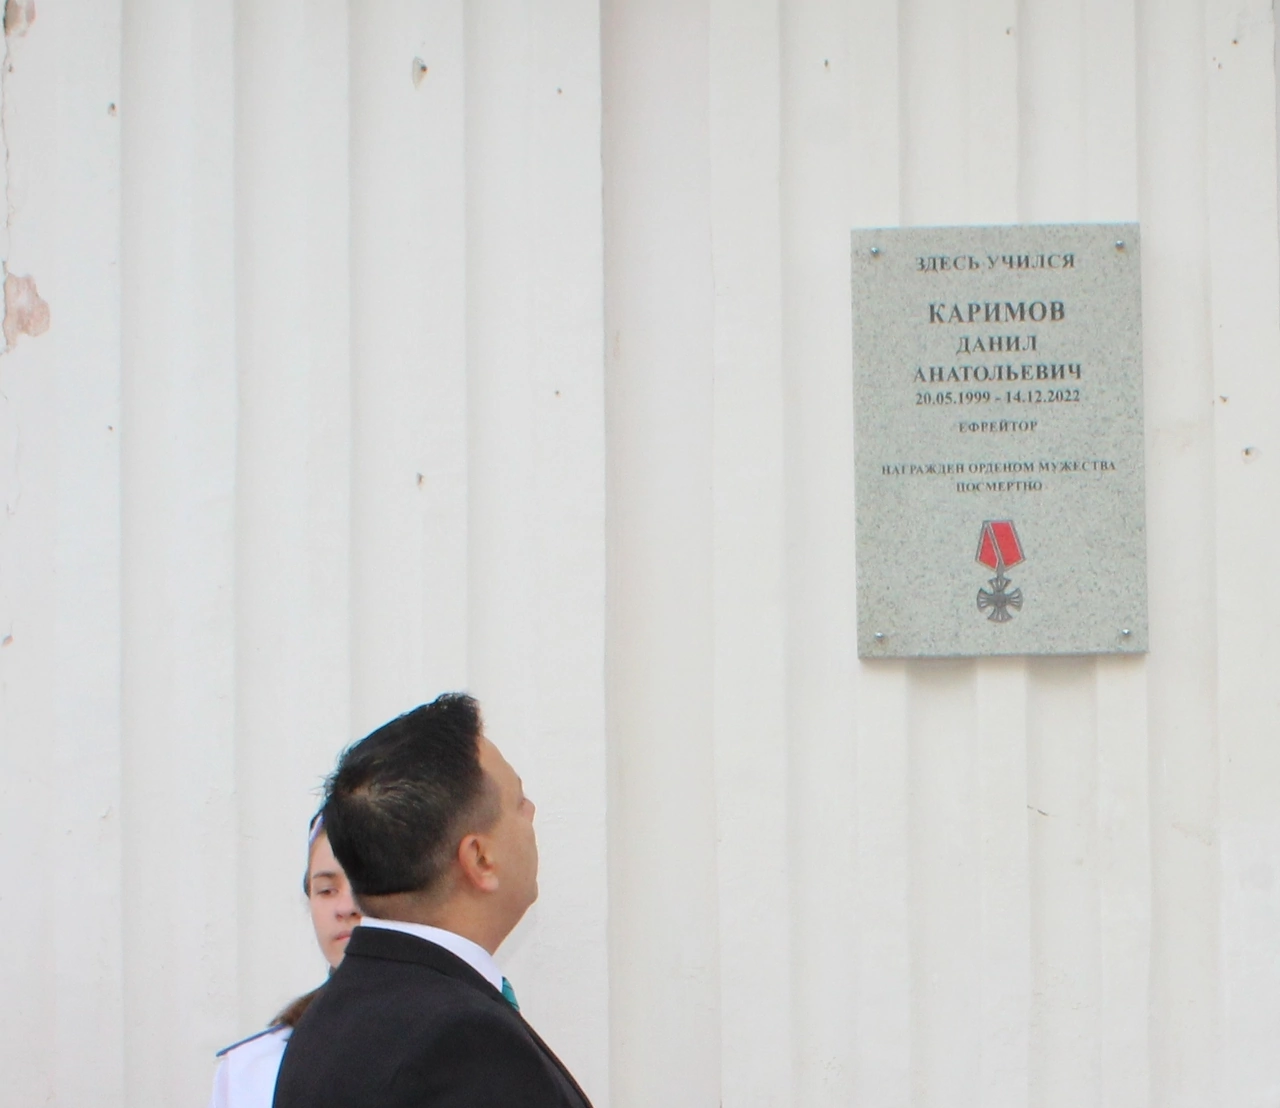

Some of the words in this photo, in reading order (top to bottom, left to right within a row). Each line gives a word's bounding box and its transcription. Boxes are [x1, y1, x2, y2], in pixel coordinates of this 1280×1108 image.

[916, 255, 979, 272] ЗДЕСЬ
[986, 253, 1076, 271] УЧИЛСЯ
[928, 301, 1066, 324] КАРИМОВ
[956, 335, 1038, 355] ДАНИЛ
[912, 363, 1083, 384] АНАТОЛЬЕВИЧ
[915, 391, 991, 406] 20.05.1999
[1005, 389, 1081, 404] 14.12.2022
[958, 419, 1039, 434] ЕФРЕЙТОР
[881, 463, 965, 476] НАГРАЖДЕН
[968, 461, 1035, 475] ОРДЕНОМ
[1038, 460, 1117, 474] МУЖЕСТВА
[956, 480, 1043, 493] ПОСМЕРТНО
